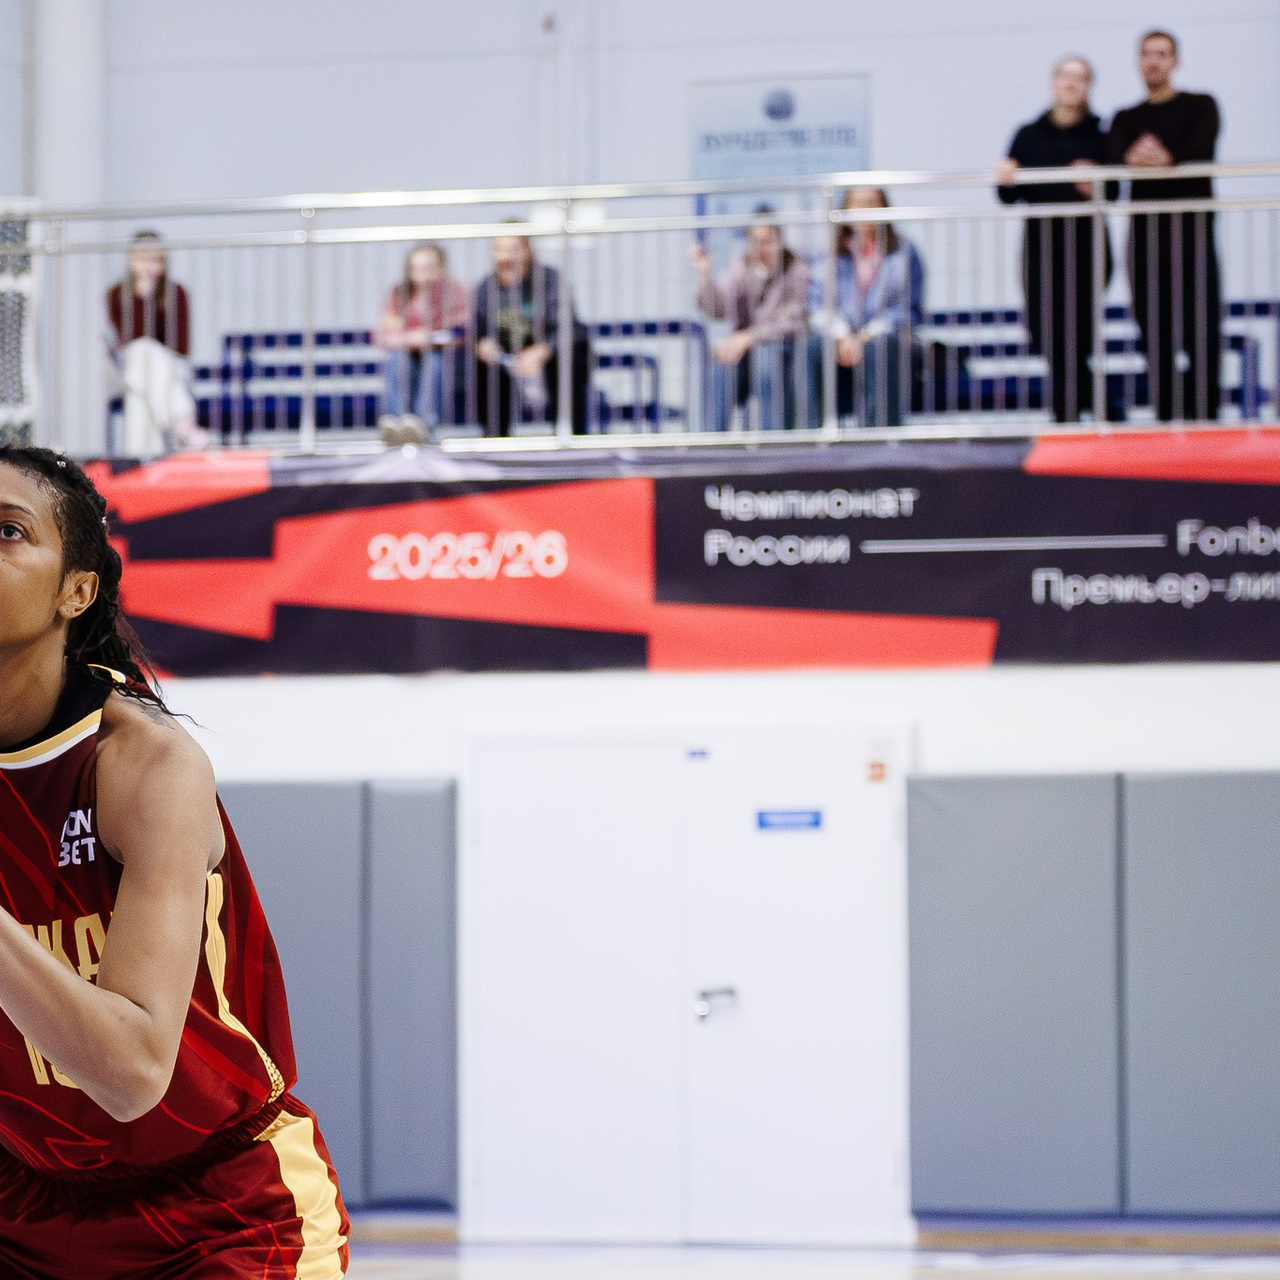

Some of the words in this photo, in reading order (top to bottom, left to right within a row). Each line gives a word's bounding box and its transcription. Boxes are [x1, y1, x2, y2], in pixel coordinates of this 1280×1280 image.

[705, 484, 920, 521] Чемпионат
[367, 528, 568, 582] 2025/26
[704, 528, 851, 567] России
